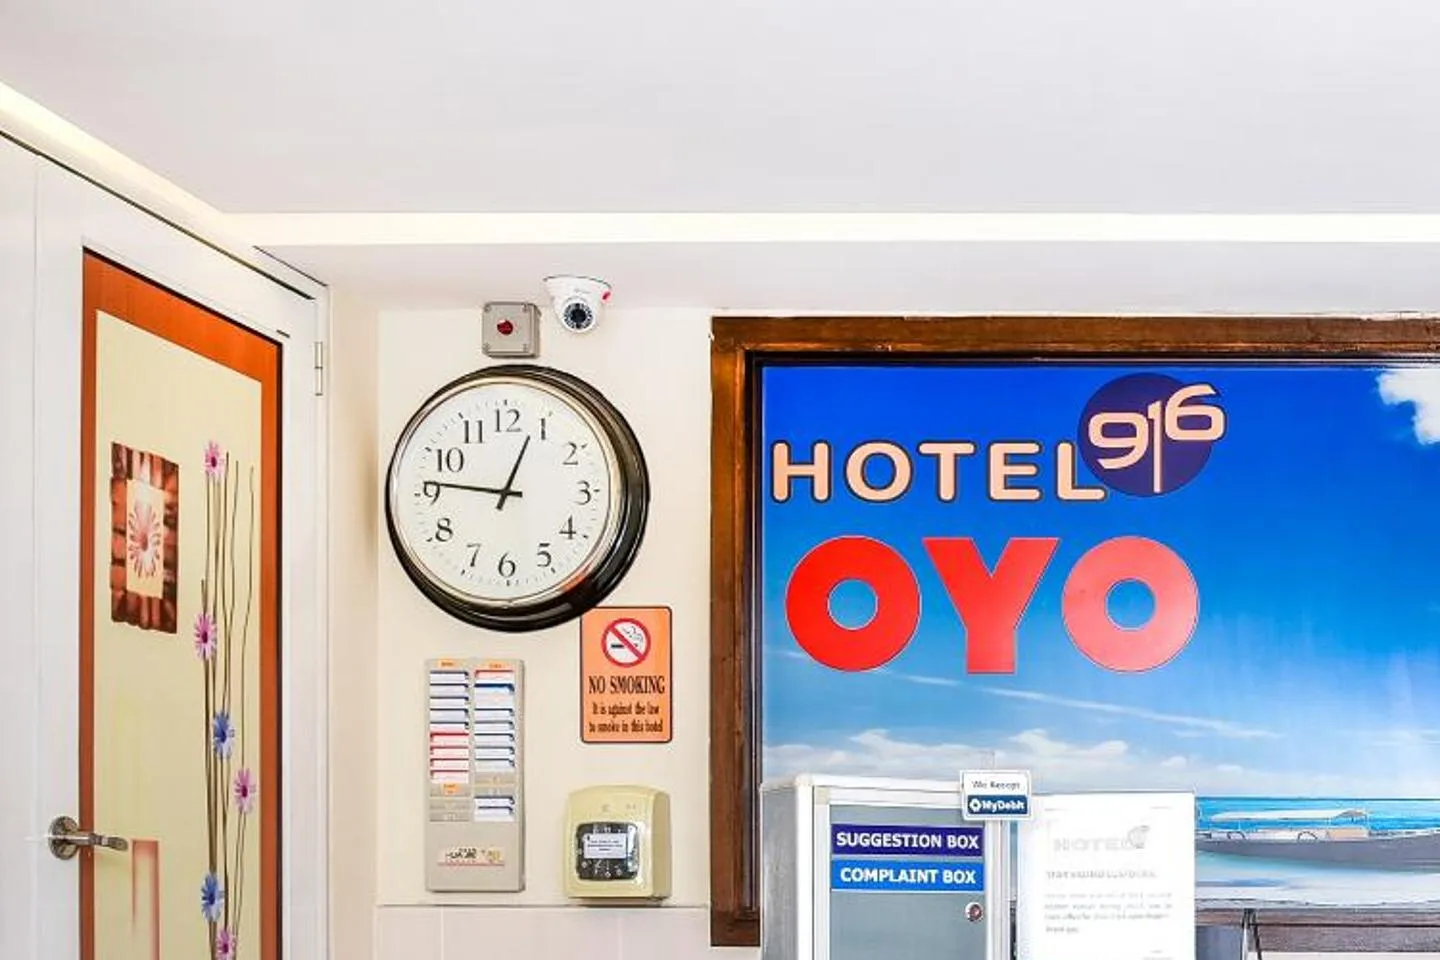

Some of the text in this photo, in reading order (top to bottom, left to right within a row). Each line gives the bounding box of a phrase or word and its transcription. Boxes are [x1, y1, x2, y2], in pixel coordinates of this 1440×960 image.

[462, 419, 484, 444] 11
[493, 408, 523, 433] 12
[539, 418, 547, 441] 1
[562, 442, 579, 466] 2
[771, 383, 1226, 502] HOTEL 916
[436, 448, 465, 473] 10
[422, 482, 441, 505] 9
[578, 480, 592, 505] 3
[434, 517, 454, 542] 8
[558, 516, 578, 541] 4
[466, 543, 483, 568] 7
[498, 553, 516, 578] 6
[536, 543, 552, 568] 5
[785, 535, 1199, 673] OYO
[588, 676, 666, 694] NO SMOKING
[600, 702, 607, 715] is
[635, 701, 646, 715] the
[982, 800, 1025, 813] MyDebit
[836, 831, 980, 849] SUGGESTION BOX
[839, 867, 976, 884] COMPLAINT BOX
